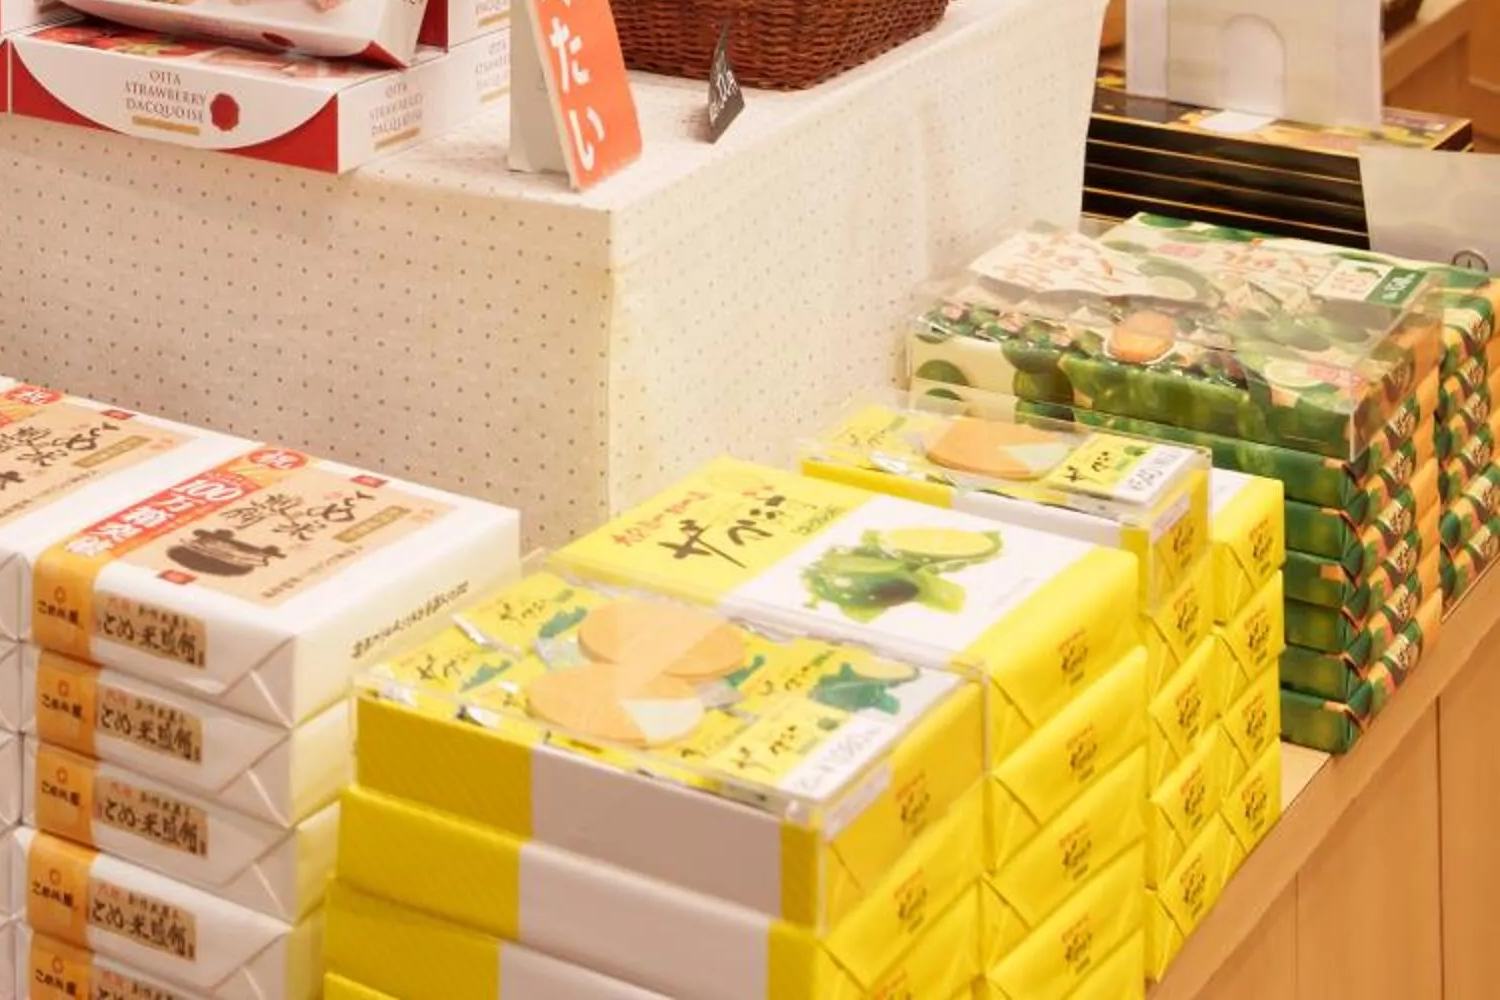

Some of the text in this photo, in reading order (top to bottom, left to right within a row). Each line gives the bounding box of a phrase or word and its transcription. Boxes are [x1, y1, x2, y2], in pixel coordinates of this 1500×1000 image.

[149, 71, 182, 86] OITA
[124, 84, 207, 106] STRAWBERRY
[125, 97, 205, 124] DACQUOISE
